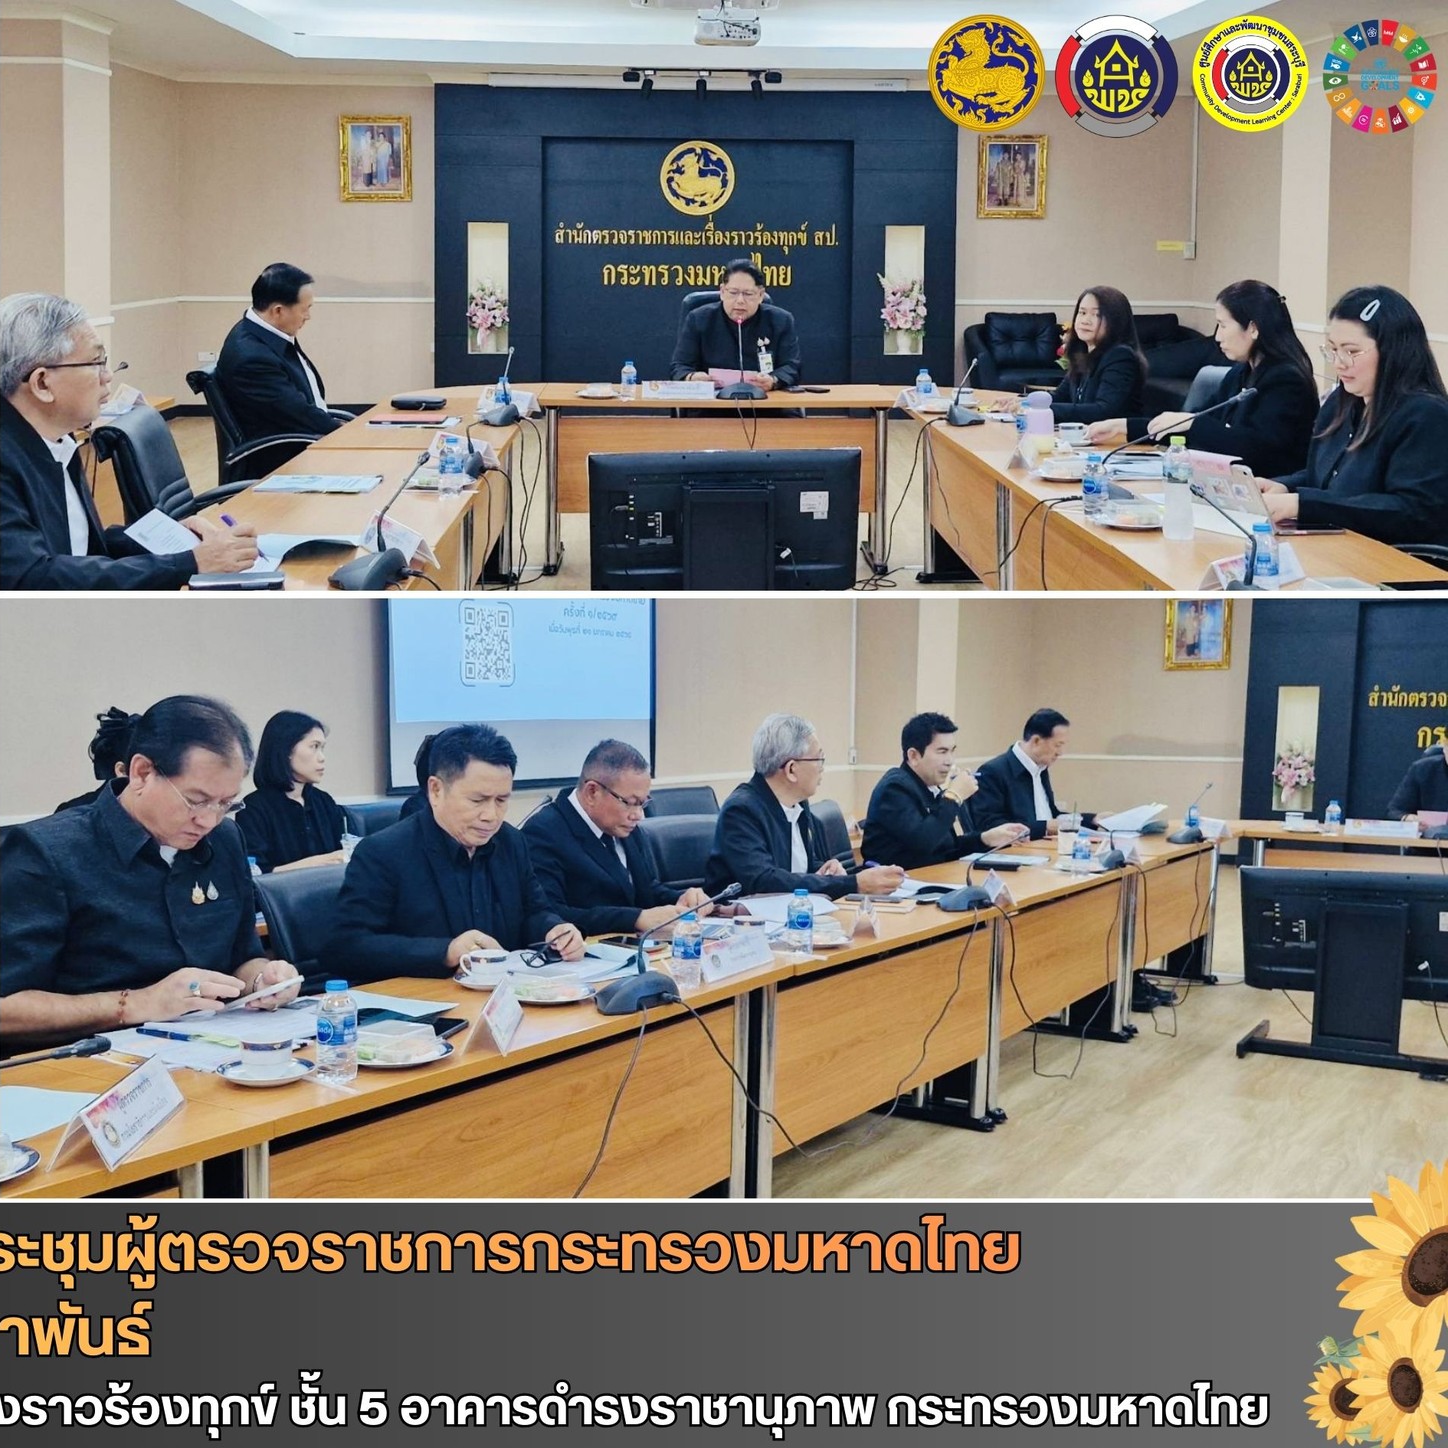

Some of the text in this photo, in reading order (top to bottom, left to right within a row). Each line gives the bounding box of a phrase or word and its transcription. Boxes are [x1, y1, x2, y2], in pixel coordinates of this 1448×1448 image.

[554, 215, 839, 254] สำนักตรวจราชการและเรื่องราวร้องทุกข์ สป.
[603, 252, 792, 286] กระทรวงมหไทย
[1368, 684, 1448, 707] สำนักตรวจ
